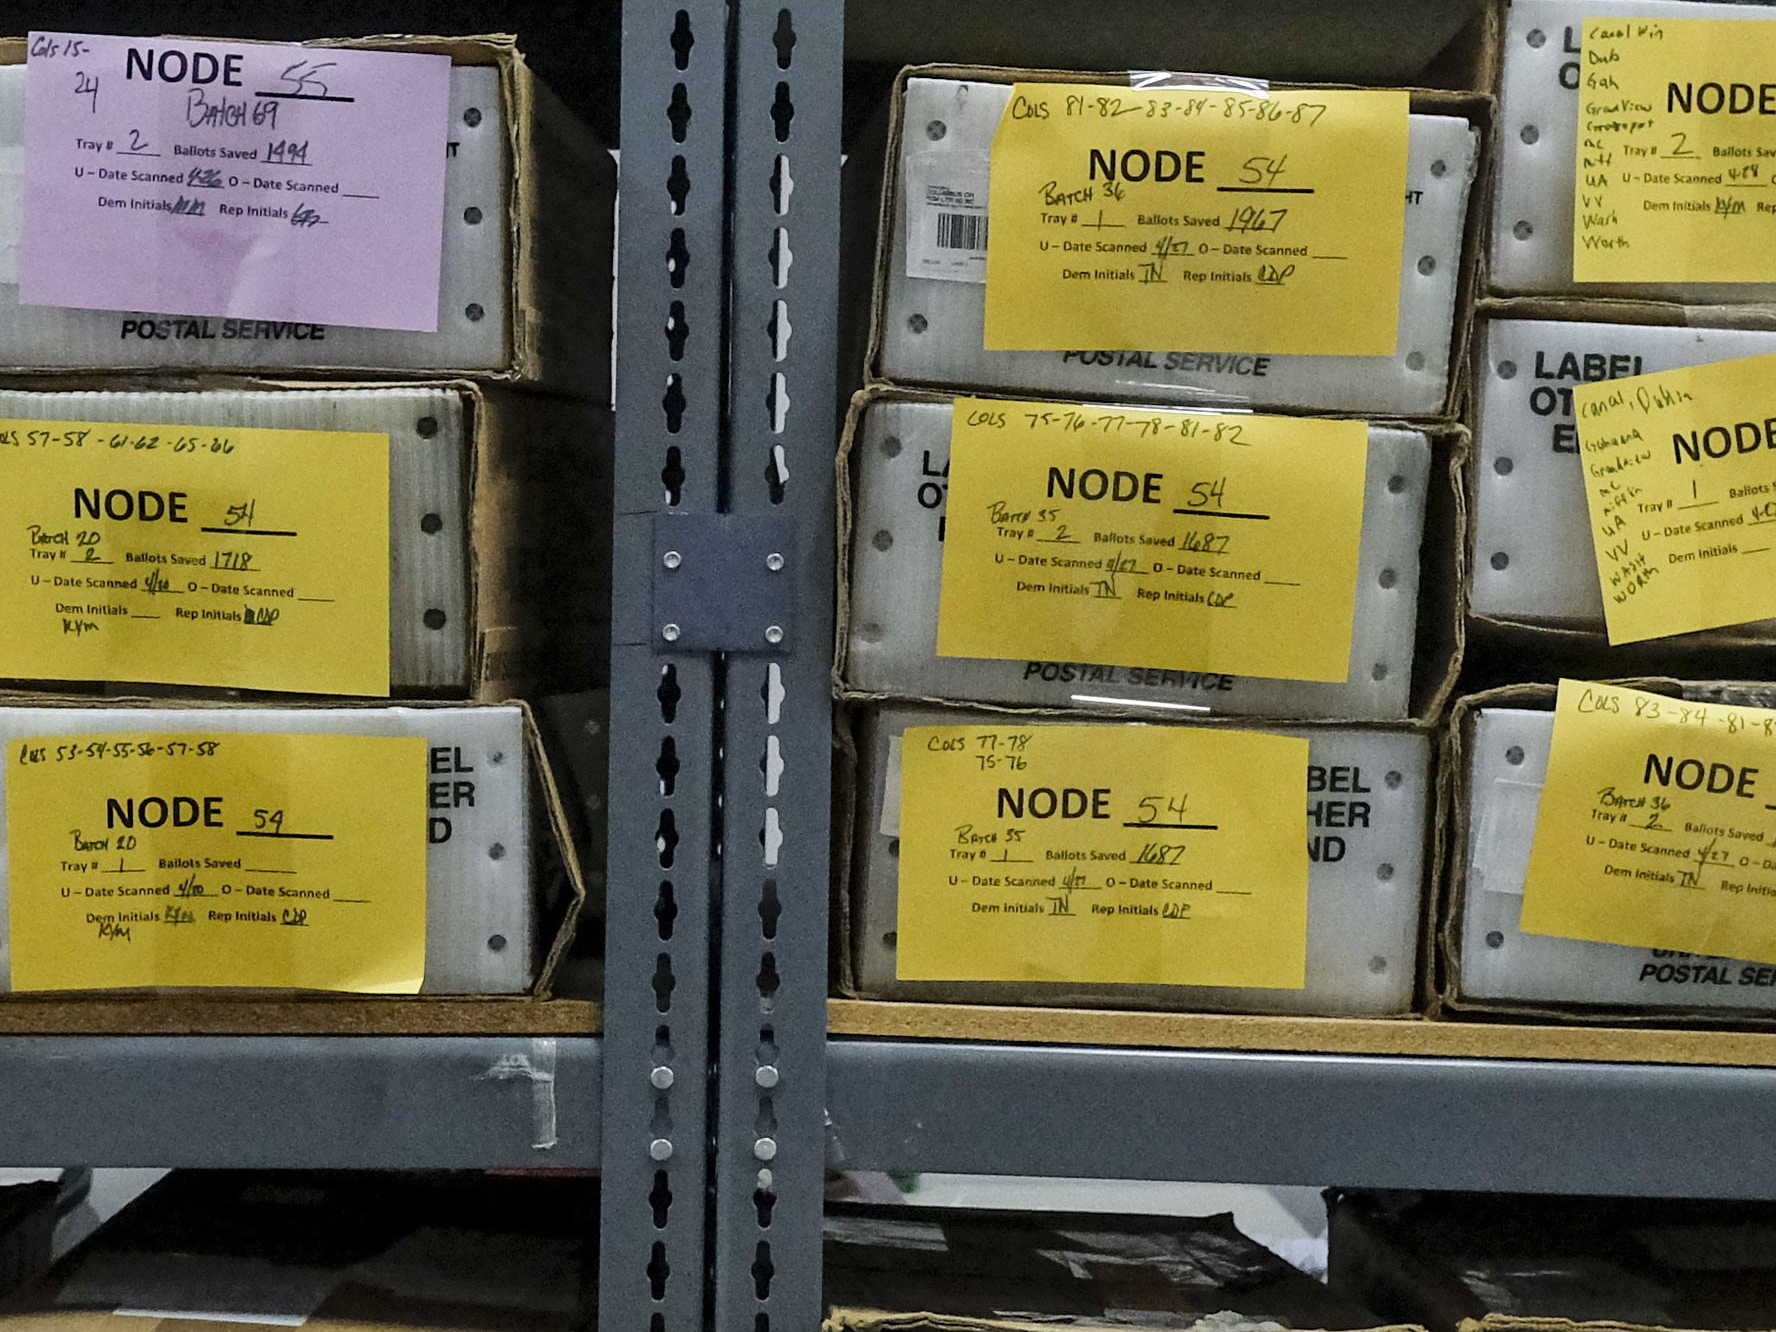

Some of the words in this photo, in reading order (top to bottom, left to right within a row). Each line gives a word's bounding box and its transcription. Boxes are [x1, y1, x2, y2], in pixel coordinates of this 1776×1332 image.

[127, 49, 243, 86] NODE
[280, 60, 337, 95] 55
[1668, 83, 1776, 114] NODE
[253, 101, 280, 128] 69
[76, 138, 102, 152] Tray
[128, 129, 149, 151] 2
[174, 144, 216, 158] Ballots
[220, 148, 257, 160] Saved
[1623, 146, 1647, 157] Tray
[1671, 133, 1694, 156] 2
[1713, 146, 1752, 158] Ballots
[1090, 149, 1205, 182] NODE
[1238, 154, 1287, 186] 54
[98, 168, 127, 180] Date
[132, 170, 183, 183] Scanned
[254, 178, 282, 190] Date
[286, 180, 339, 194] Scanned
[1586, 175, 1608, 188] UA
[98, 197, 126, 209] Dem
[130, 198, 171, 211] Initials
[220, 203, 243, 217] Rep
[248, 206, 288, 219] Initials
[1643, 201, 1669, 212] Dem
[1673, 201, 1711, 212] Initials
[1040, 213, 1066, 227] Tray
[1138, 214, 1179, 227] Ballots
[1183, 215, 1220, 227] Saved
[1228, 207, 1287, 233] 1967
[1063, 241, 1092, 253] Date
[1096, 241, 1147, 254] Scanned
[1223, 245, 1252, 256] Date
[1256, 245, 1307, 257] Scanned
[1583, 235, 1629, 251] Worth
[1063, 269, 1090, 280] Dem
[1094, 268, 1135, 280] Initials
[1183, 271, 1208, 283] Rep
[1211, 271, 1252, 282] Initials
[121, 319, 215, 340] POSTAL
[222, 319, 325, 341] SERVICE
[1048, 467, 1163, 503] NODE
[1186, 481, 1230, 509] 54
[75, 488, 188, 523] NODE
[224, 501, 256, 526] 54
[1644, 754, 1758, 798] NODE
[107, 797, 223, 828] NODE
[252, 809, 285, 834] 54
[998, 788, 1110, 818] NODE
[1136, 797, 1191, 825] 54
[1639, 964, 1731, 985] POSTAL
